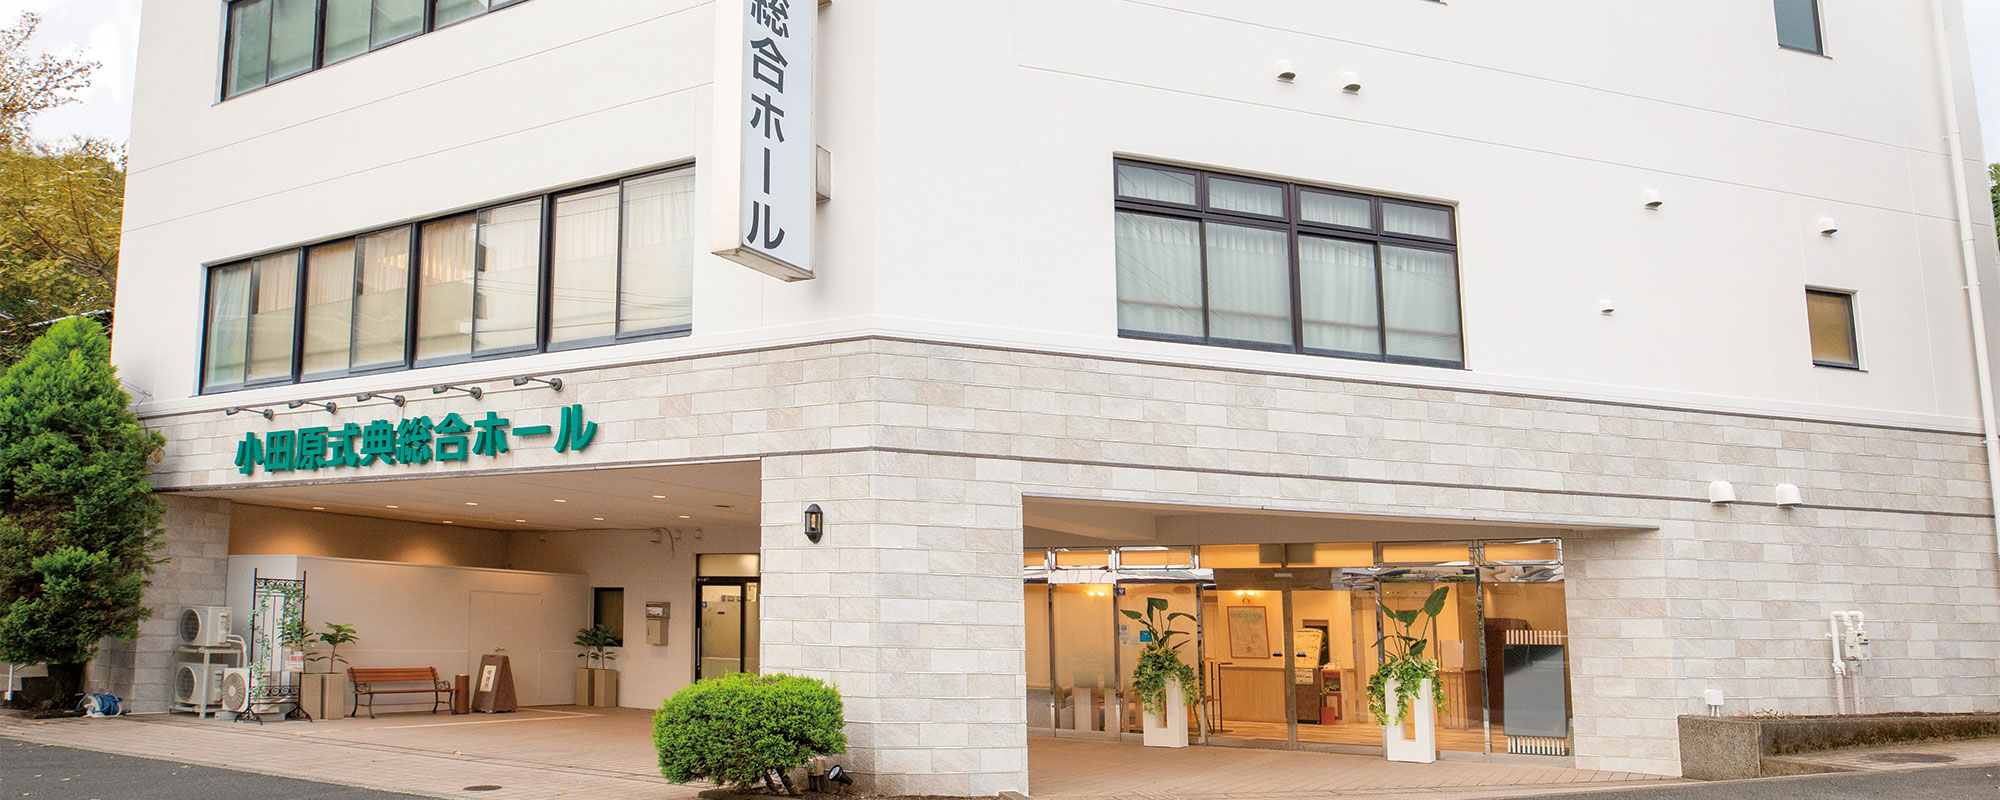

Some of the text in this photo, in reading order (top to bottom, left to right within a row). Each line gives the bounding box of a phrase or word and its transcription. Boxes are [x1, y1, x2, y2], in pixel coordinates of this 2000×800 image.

[235, 404, 597, 475] 小田原式典総合ホール
